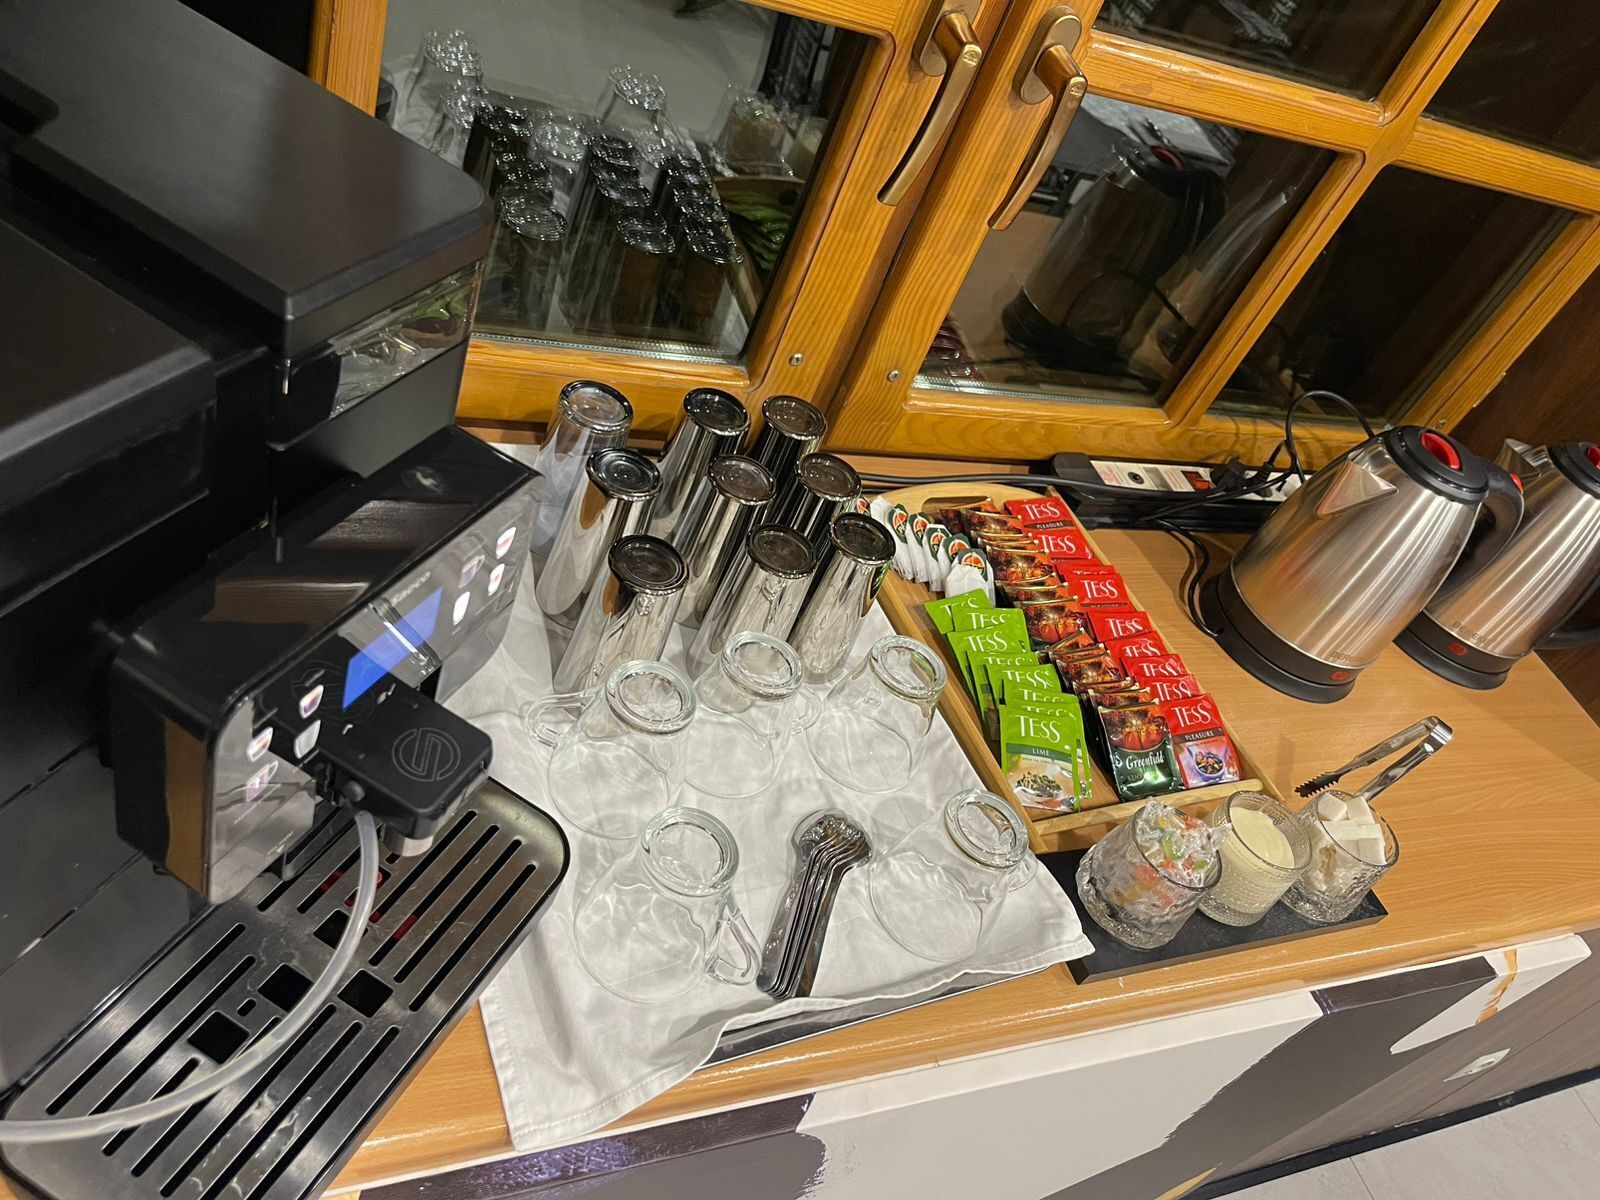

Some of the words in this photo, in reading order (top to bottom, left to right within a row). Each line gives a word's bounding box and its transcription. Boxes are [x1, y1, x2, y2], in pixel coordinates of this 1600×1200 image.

[1021, 502, 1060, 520] TESS
[1037, 535, 1076, 554] TESS
[1080, 580, 1118, 599] TESS
[963, 630, 1007, 653] TESS
[1151, 681, 1192, 702] TESS
[1170, 702, 1212, 728] TESS
[1014, 714, 1061, 744] TESS
[1185, 730, 1214, 741] PLEASURE
[1032, 747, 1050, 757] LIME
[1125, 751, 1165, 770] Greenfield
